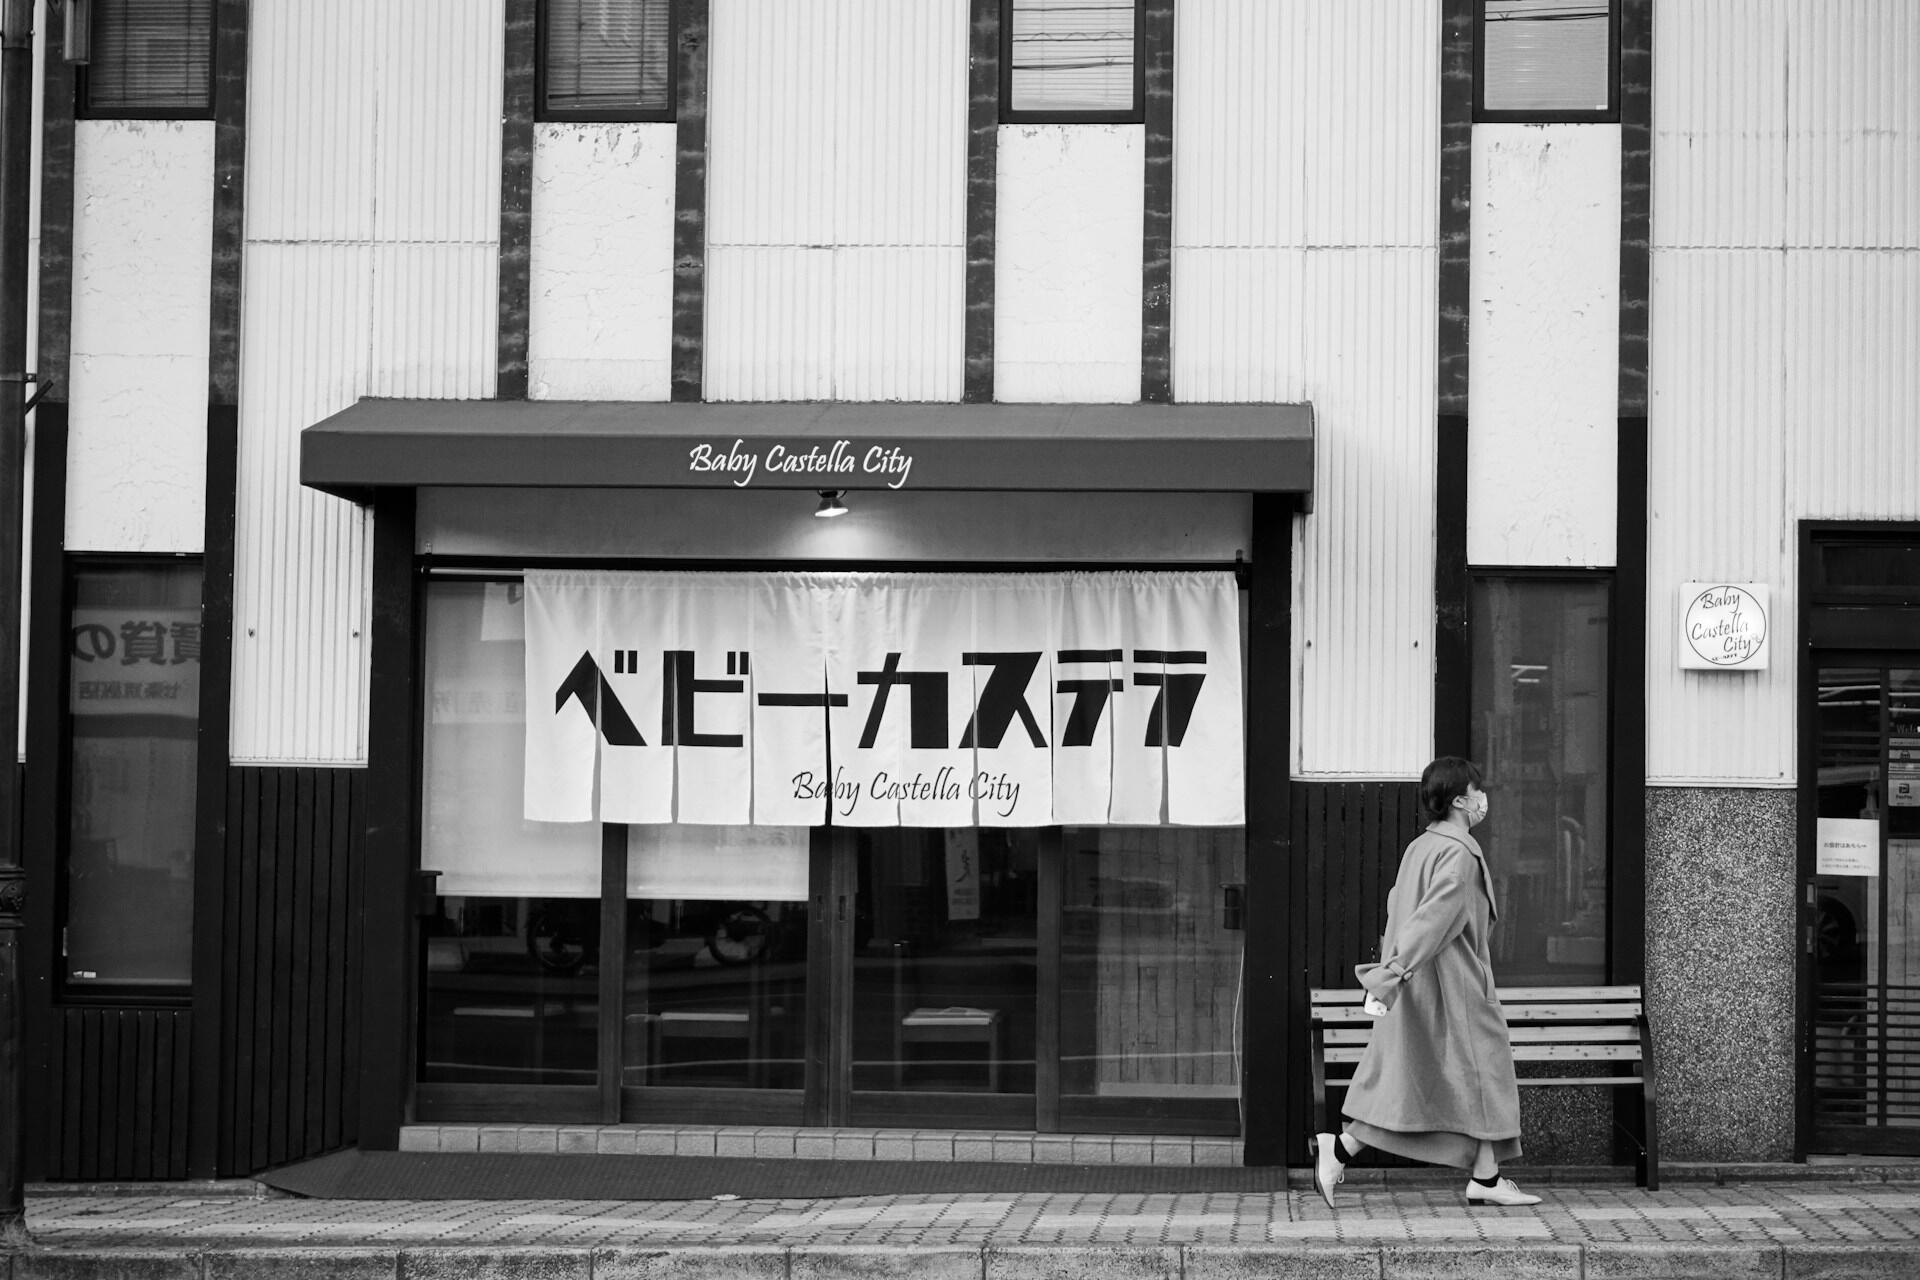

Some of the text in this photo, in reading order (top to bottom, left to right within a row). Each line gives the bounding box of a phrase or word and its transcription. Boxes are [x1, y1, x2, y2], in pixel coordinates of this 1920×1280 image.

[689, 438, 914, 490] Baby Castella City
[1700, 586, 1741, 614] Baby
[1691, 612, 1749, 641] Castella
[1723, 635, 1752, 659] City
[555, 649, 1207, 749] ベビーカステラ
[792, 765, 1020, 818] Baby Castella City
